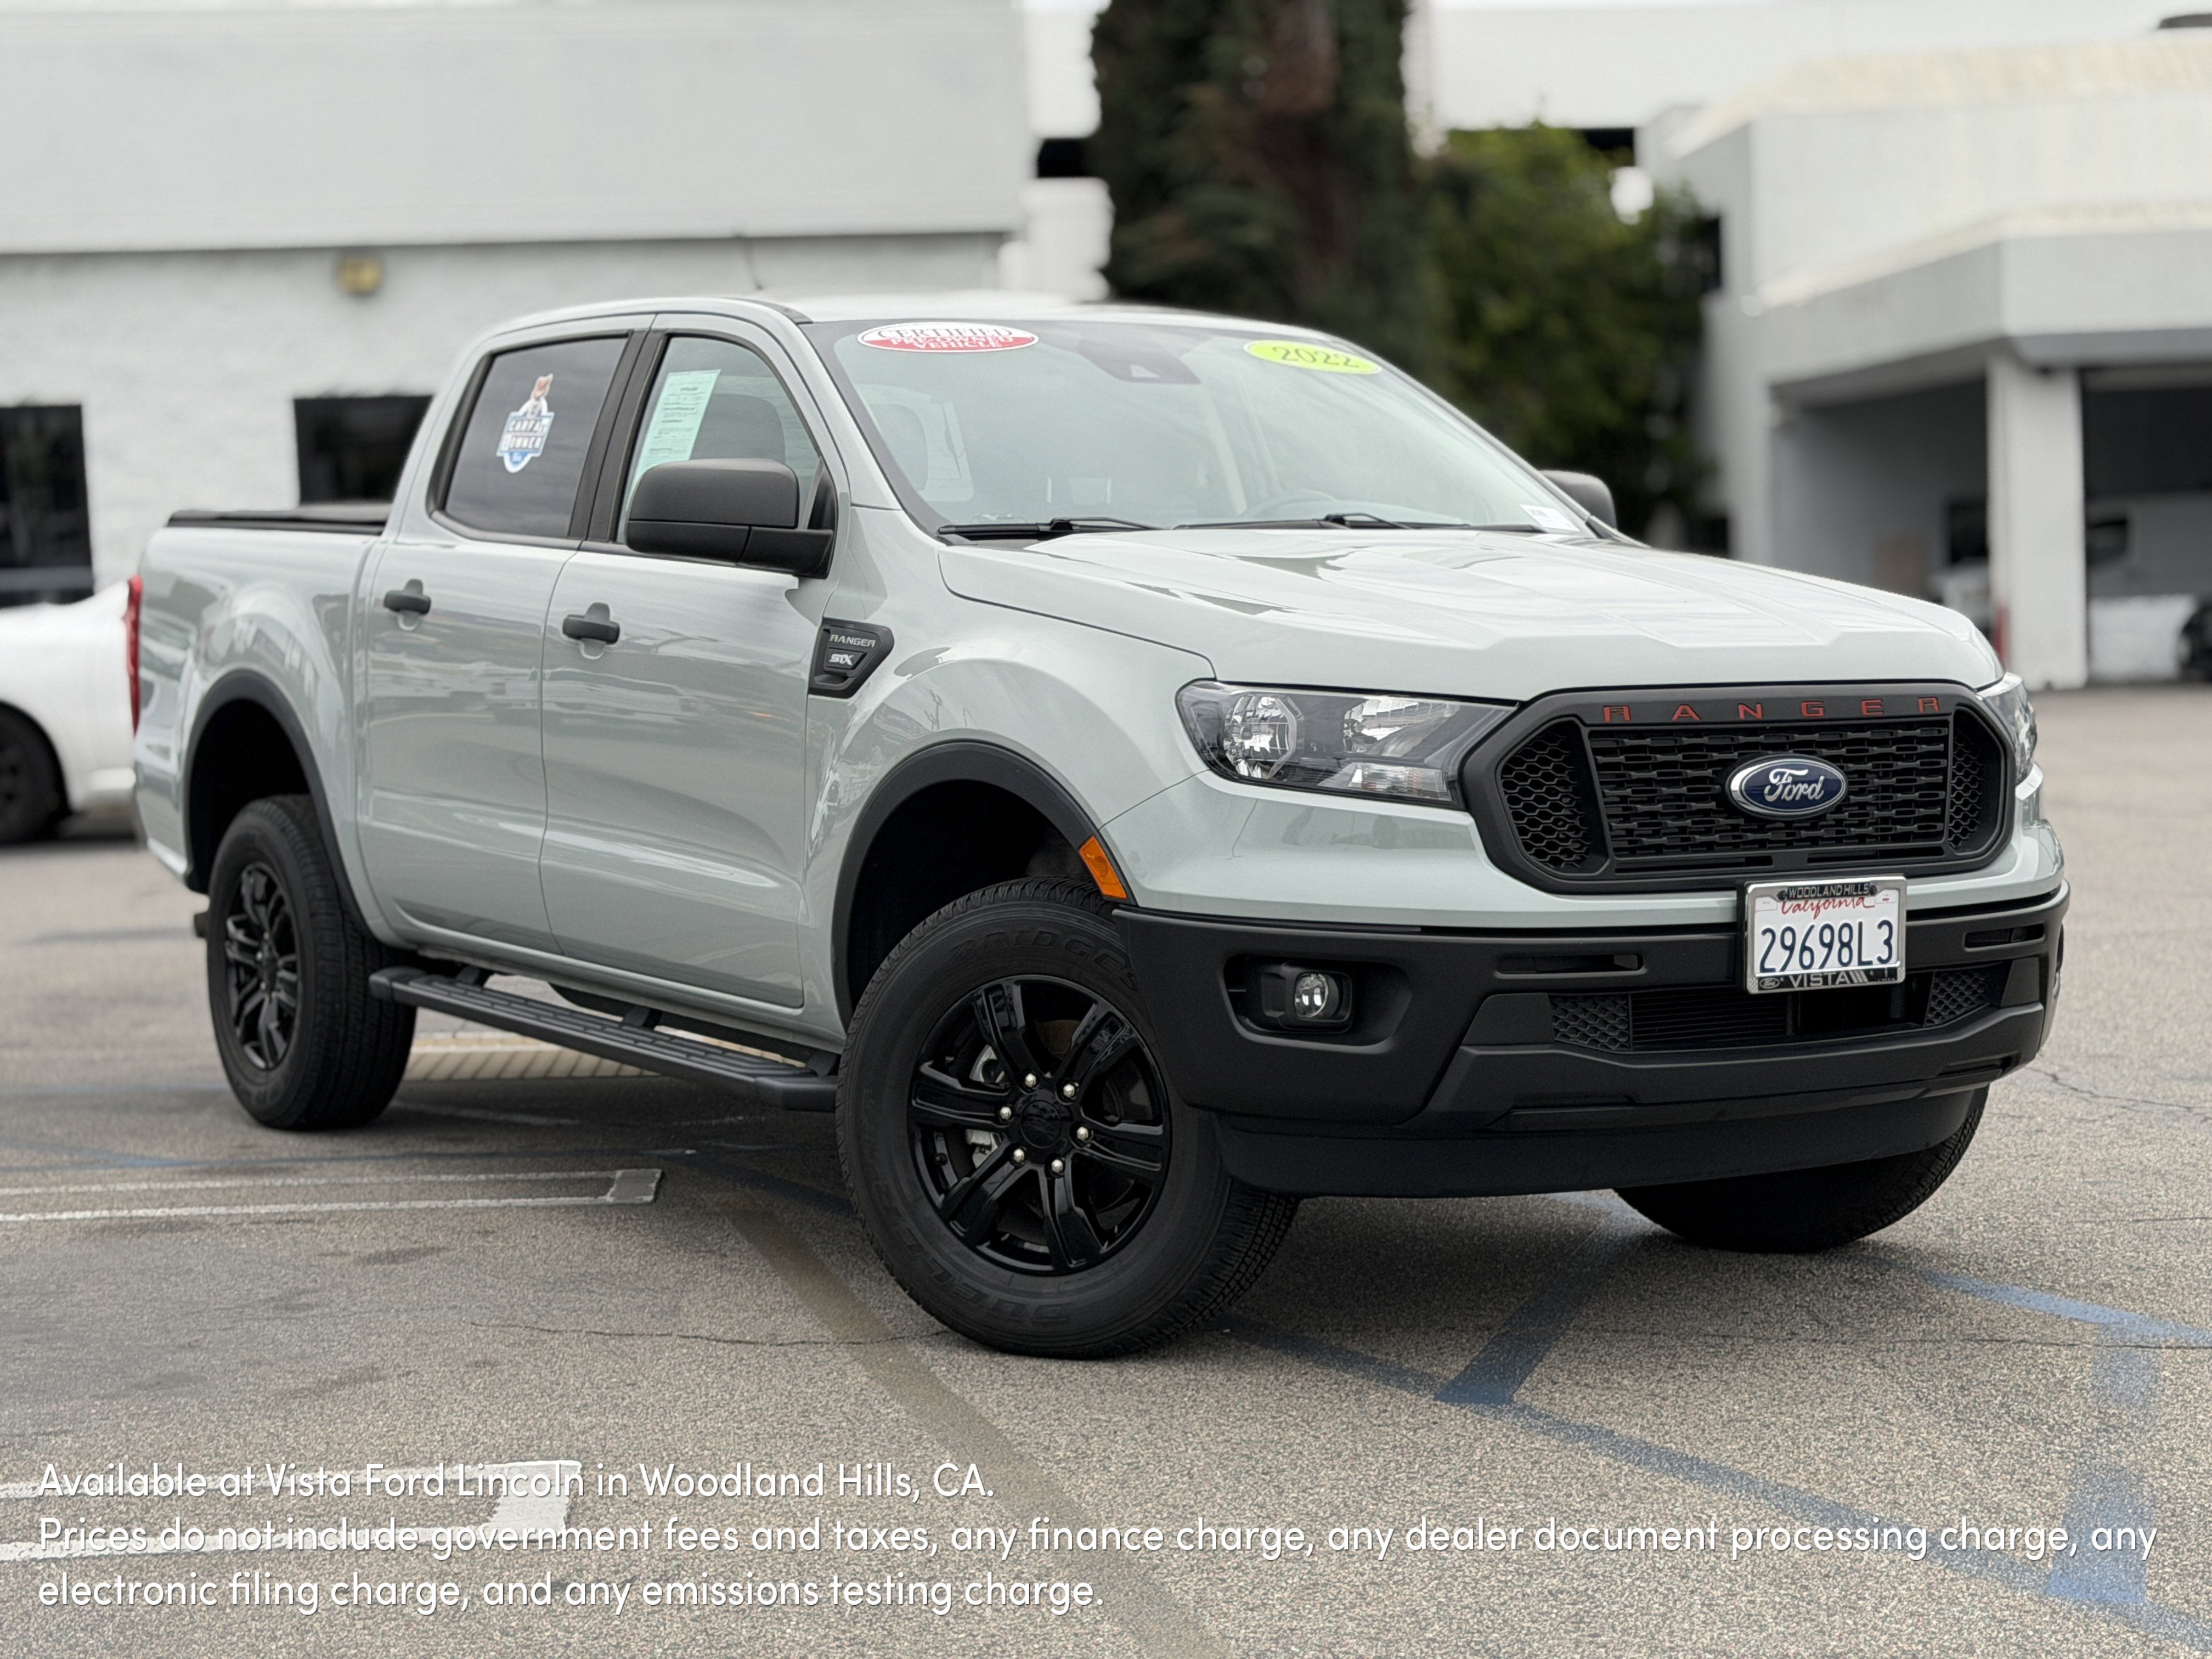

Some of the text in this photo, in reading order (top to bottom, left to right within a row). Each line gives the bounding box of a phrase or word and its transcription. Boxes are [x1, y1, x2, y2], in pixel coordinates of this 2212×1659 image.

[878, 328, 1013, 338] CERTIFIED
[890, 335, 1014, 345] PRE-OWNED
[912, 338, 1003, 348] VEHICLE
[1272, 346, 1359, 368] 2022
[830, 634, 876, 647] RANGER
[828, 653, 854, 665] STX
[1602, 697, 1940, 723] RANGER
[1764, 768, 1825, 802] Ford
[1788, 883, 1869, 899] WOODLAND HILLS
[1781, 896, 1876, 919] California
[1759, 919, 1893, 974] 29698L3
[1788, 972, 1851, 988] VISTA
